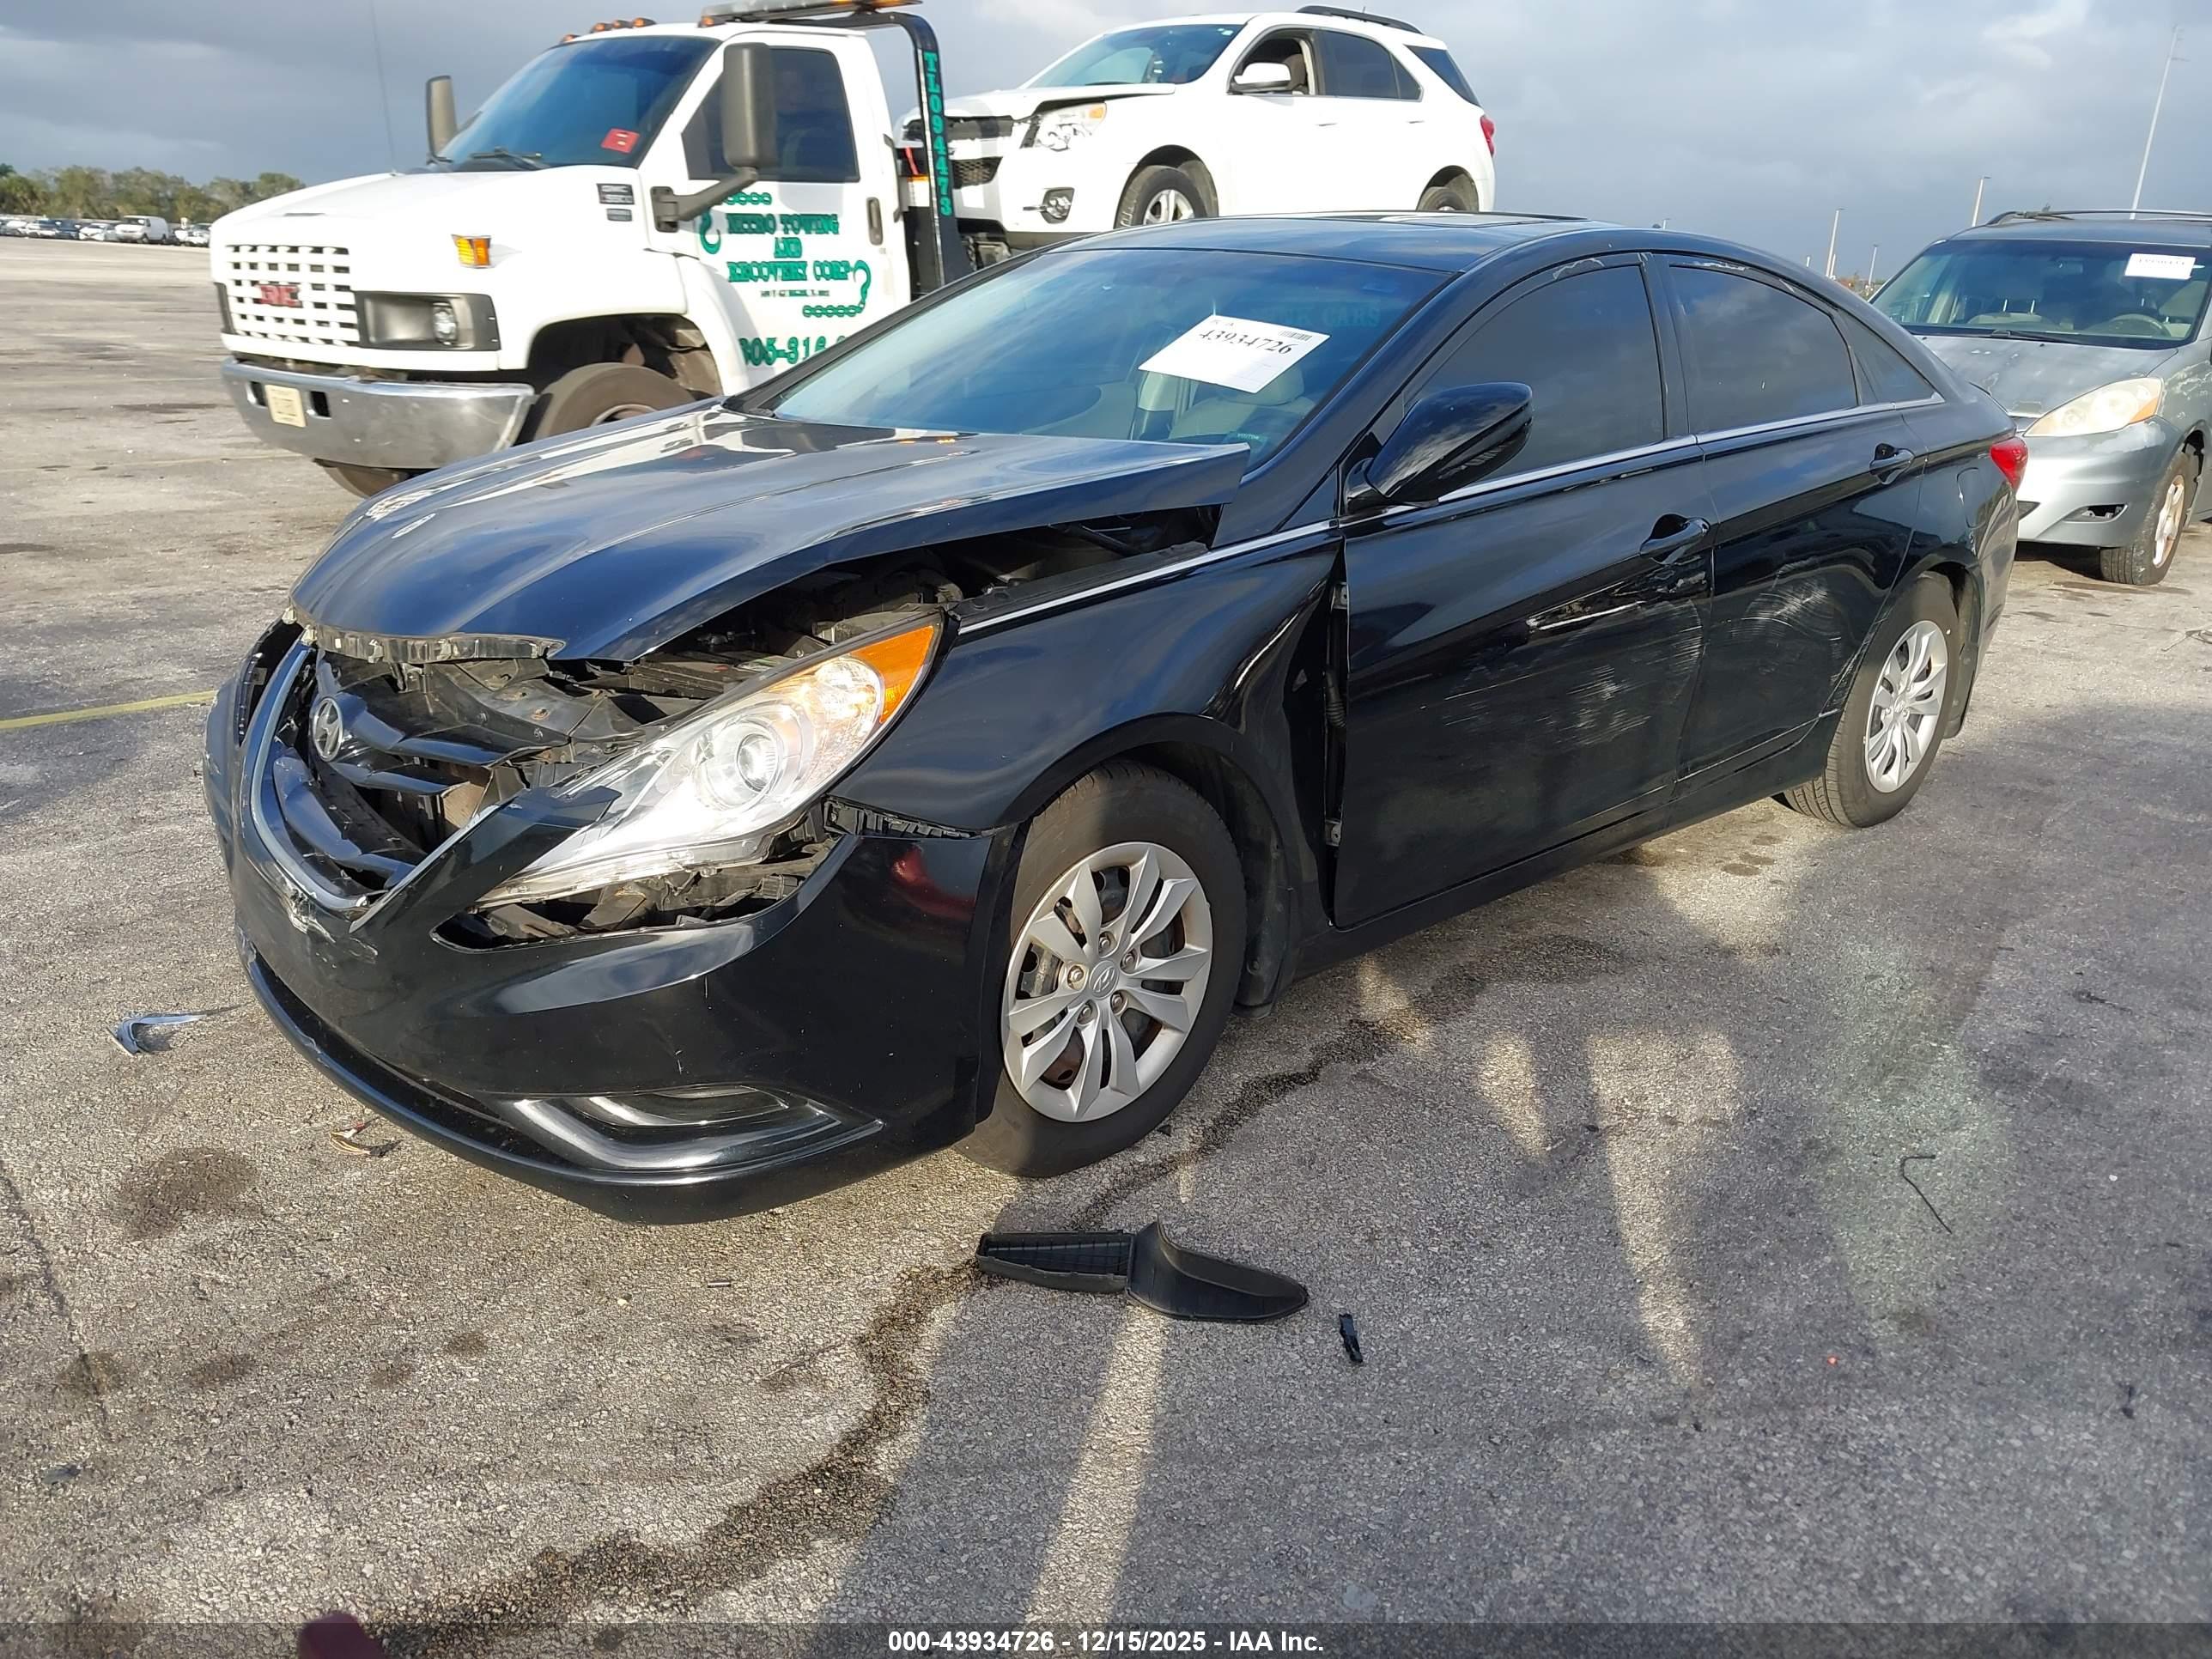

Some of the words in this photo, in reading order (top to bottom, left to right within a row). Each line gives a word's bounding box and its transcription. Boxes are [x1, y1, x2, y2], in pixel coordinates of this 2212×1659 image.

[779, 213, 840, 234] TOWING
[774, 237, 803, 258] AND
[726, 261, 808, 283] RECOVERY
[1199, 329, 1299, 355] 43934726
